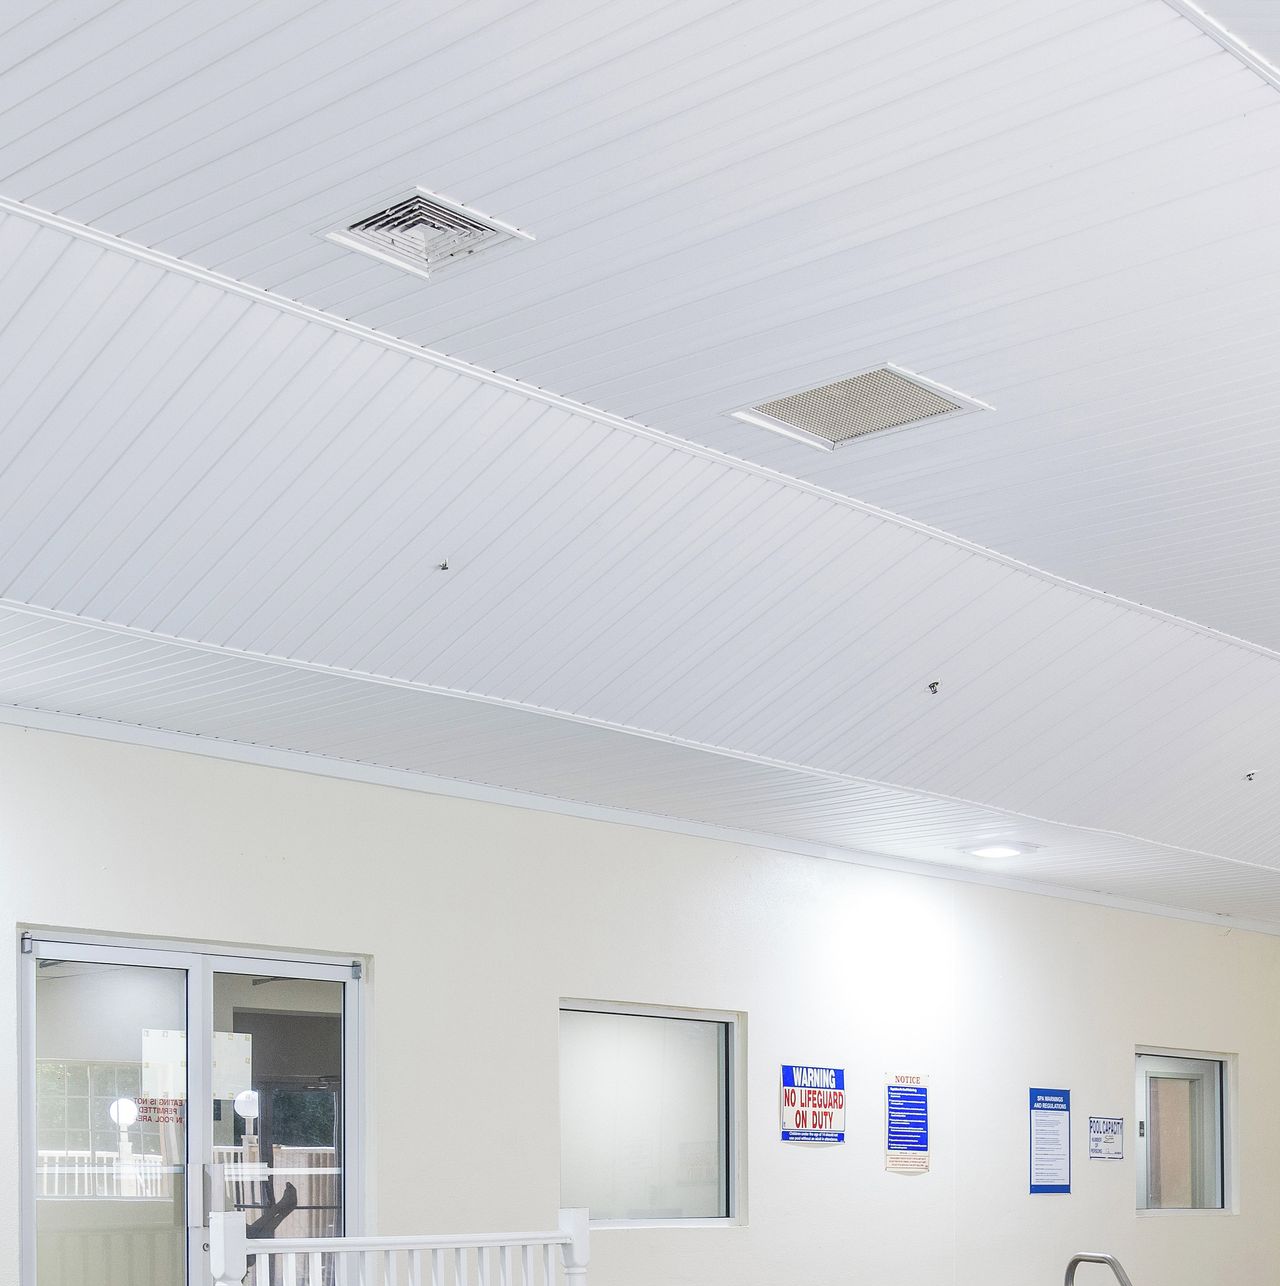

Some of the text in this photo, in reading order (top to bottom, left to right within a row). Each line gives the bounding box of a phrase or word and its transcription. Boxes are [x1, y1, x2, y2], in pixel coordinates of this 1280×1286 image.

[792, 1067, 836, 1088] WARNING
[895, 1075, 920, 1084] NOTICE
[784, 1089, 843, 1109] NO LIFEGUARD
[795, 1110, 833, 1129] ON DUTY
[1090, 1120, 1102, 1133] POOL
